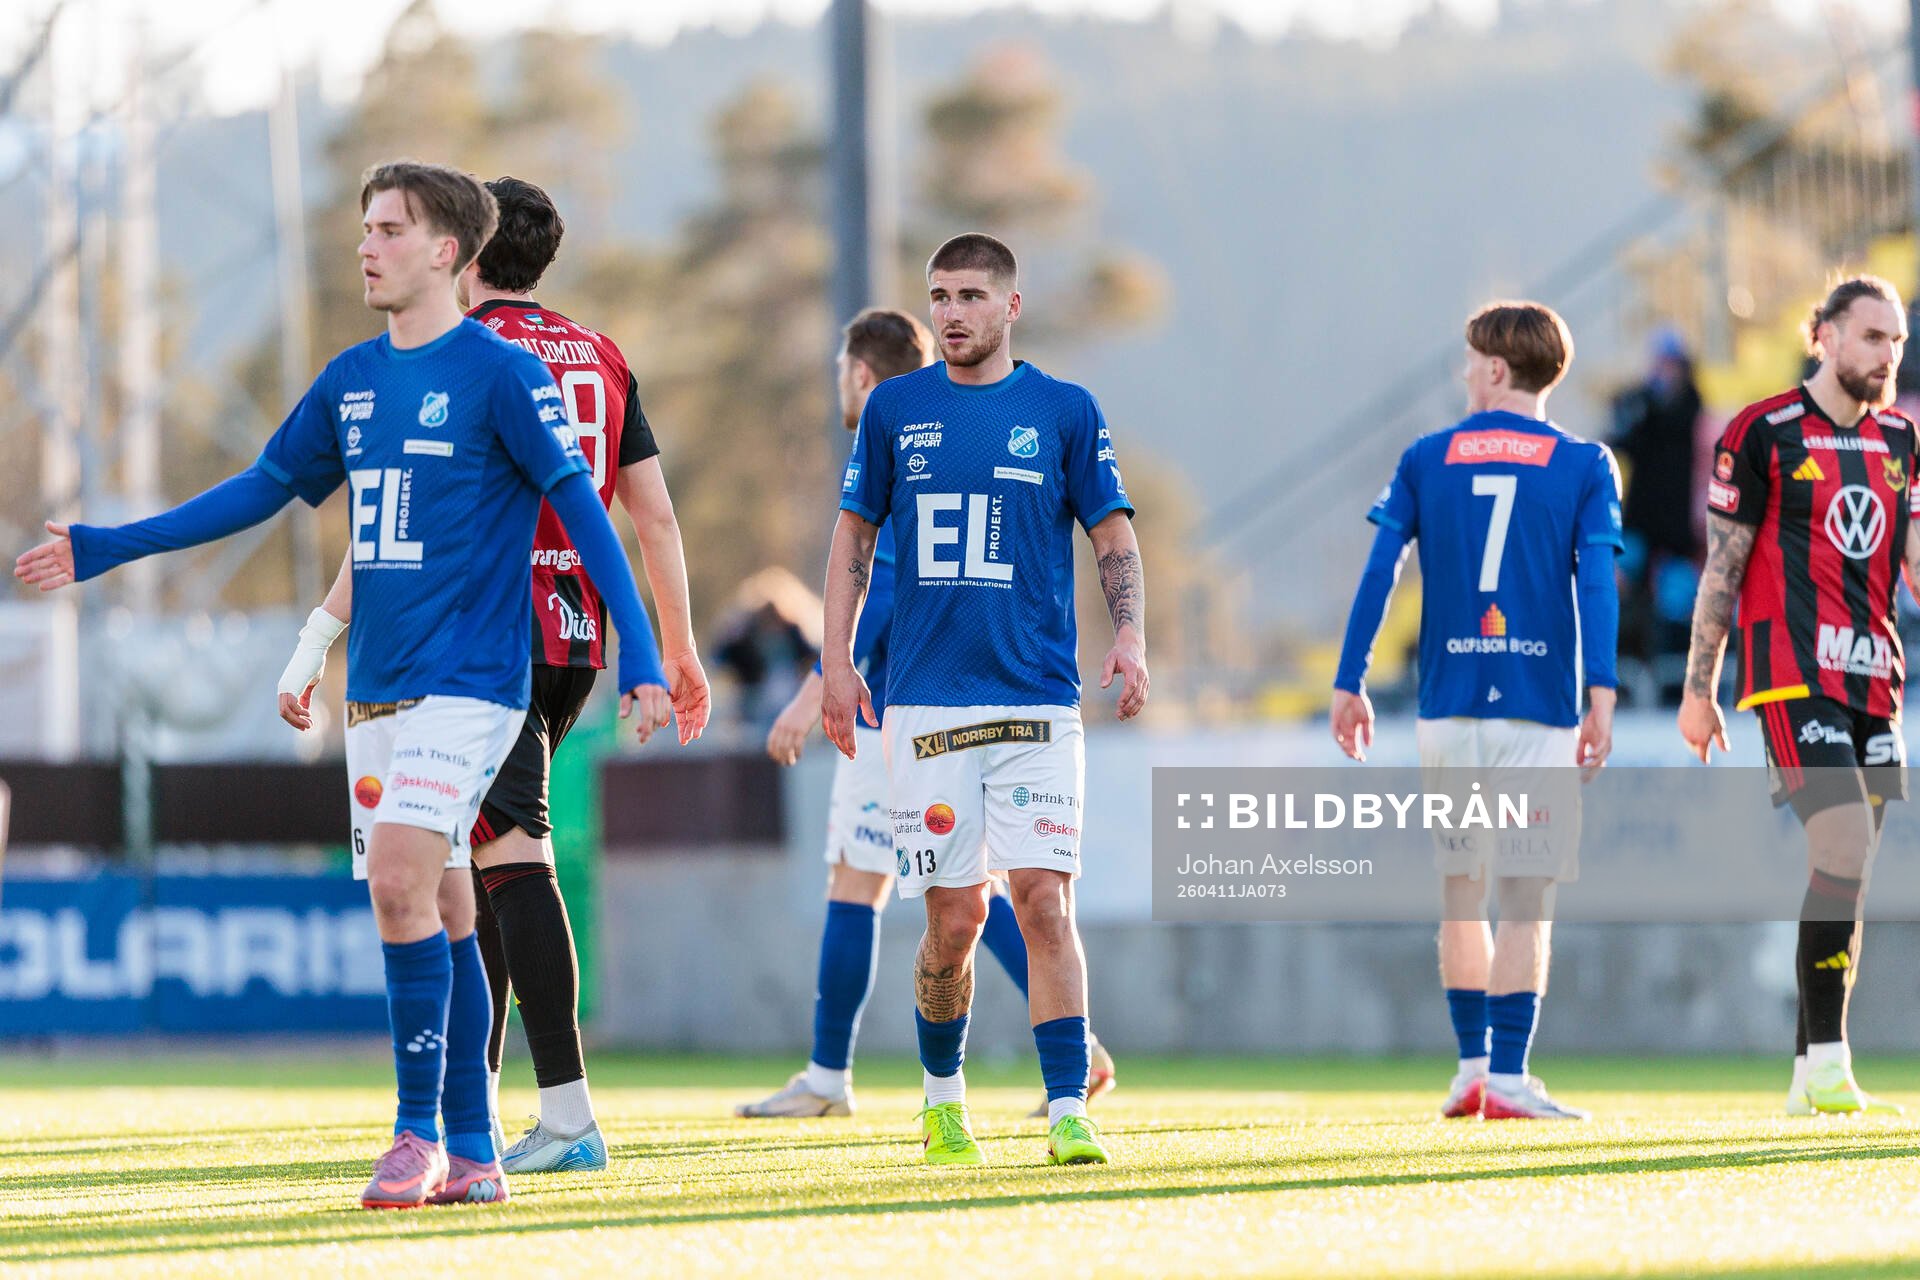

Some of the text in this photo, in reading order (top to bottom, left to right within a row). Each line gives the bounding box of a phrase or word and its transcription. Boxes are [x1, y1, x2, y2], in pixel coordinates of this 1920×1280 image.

[561, 371, 606, 492] 8
[903, 423, 935, 431] CRAFT
[914, 432, 942, 440] INTER
[913, 440, 942, 448] SPORT
[1457, 437, 1542, 457] elcenter
[349, 468, 423, 561] EL
[989, 494, 1003, 560] PROJEKT.
[916, 493, 1013, 581] EL
[1472, 475, 1517, 592] 7
[915, 735, 945, 758] XL
[952, 727, 1004, 746] NORRBY
[1009, 722, 1034, 737] TRÄ
[1032, 793, 1064, 805] Brink
[353, 828, 365, 855] 6
[916, 849, 936, 876] 13
